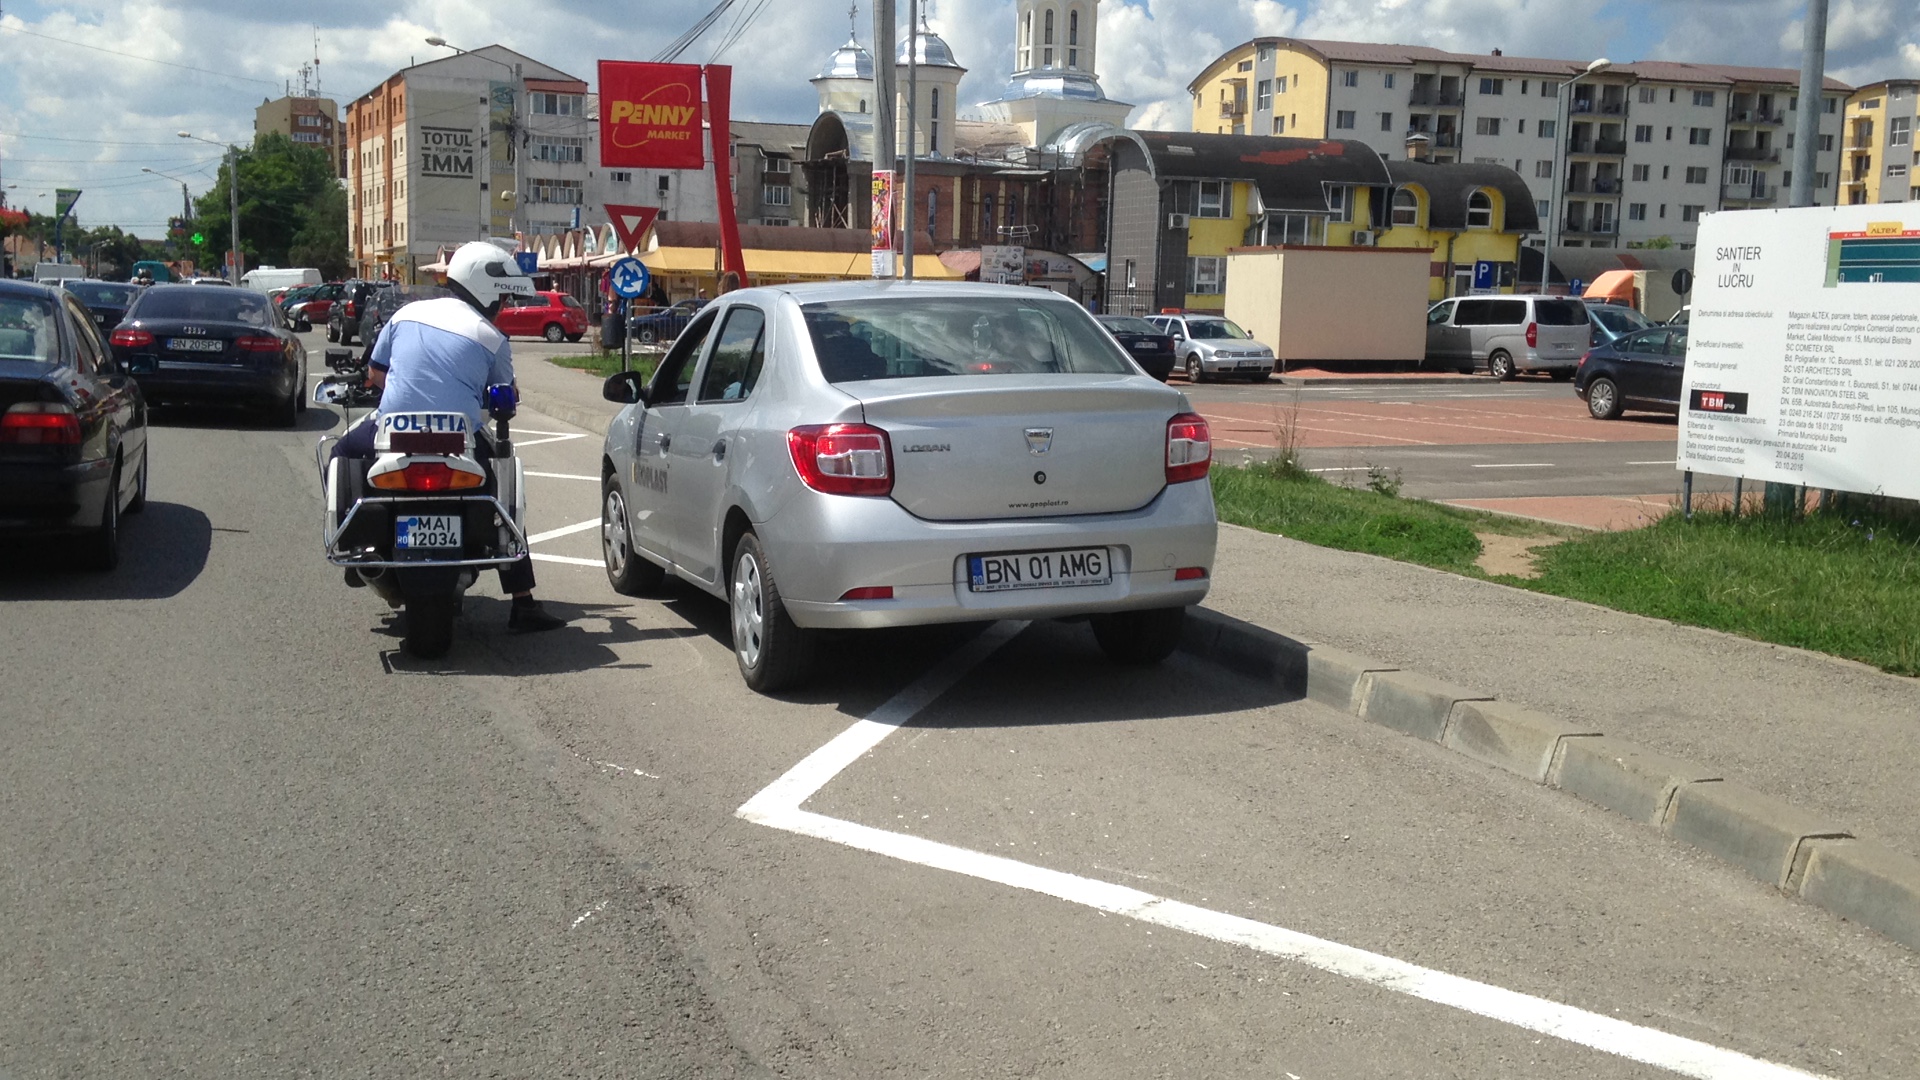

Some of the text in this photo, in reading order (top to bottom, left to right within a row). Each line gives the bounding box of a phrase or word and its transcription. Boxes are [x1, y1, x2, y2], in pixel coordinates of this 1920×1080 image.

[610, 100, 695, 126] PENNY
[421, 132, 473, 147] TOTUL
[647, 130, 691, 140] MARKET
[421, 153, 473, 173] IMM
[1716, 246, 1762, 261] SANTIER
[1479, 263, 1489, 279] P
[1732, 262, 1741, 273] IN
[1573, 279, 1580, 288] P
[1718, 274, 1754, 288] LUCRU
[1789, 312, 1811, 321] Magazin
[1788, 323, 1804, 331] pentru
[1805, 323, 1830, 331] realizarea
[1843, 324, 1865, 333] Complex
[1867, 324, 1894, 333] Comercial
[1895, 325, 1915, 333] comun
[172, 340, 186, 349] BN
[1786, 344, 1835, 353] SC COMETEX SRL
[1784, 364, 1853, 377] SC VST ARCHITECTS SRL
[1902, 382, 1918, 391] 0744
[1782, 386, 1790, 395] SC
[1804, 388, 1838, 398] INNOVATION
[1838, 390, 1857, 399] STEEL
[1858, 392, 1870, 400] SRL
[1702, 397, 1724, 407] TBM
[1876, 404, 1886, 413] km
[1778, 418, 1786, 427] 23
[1786, 420, 1795, 428] din
[1795, 420, 1807, 429] data
[1807, 420, 1815, 429] de
[1778, 430, 1799, 439] Primaria
[1829, 434, 1848, 443] Bistrita
[903, 443, 951, 453] LOGAN
[1008, 500, 1069, 509] www.geoplast.ro
[417, 516, 451, 533] MAI
[397, 532, 458, 546] RO 12034
[972, 552, 1102, 585] RO BN 01 AMG
